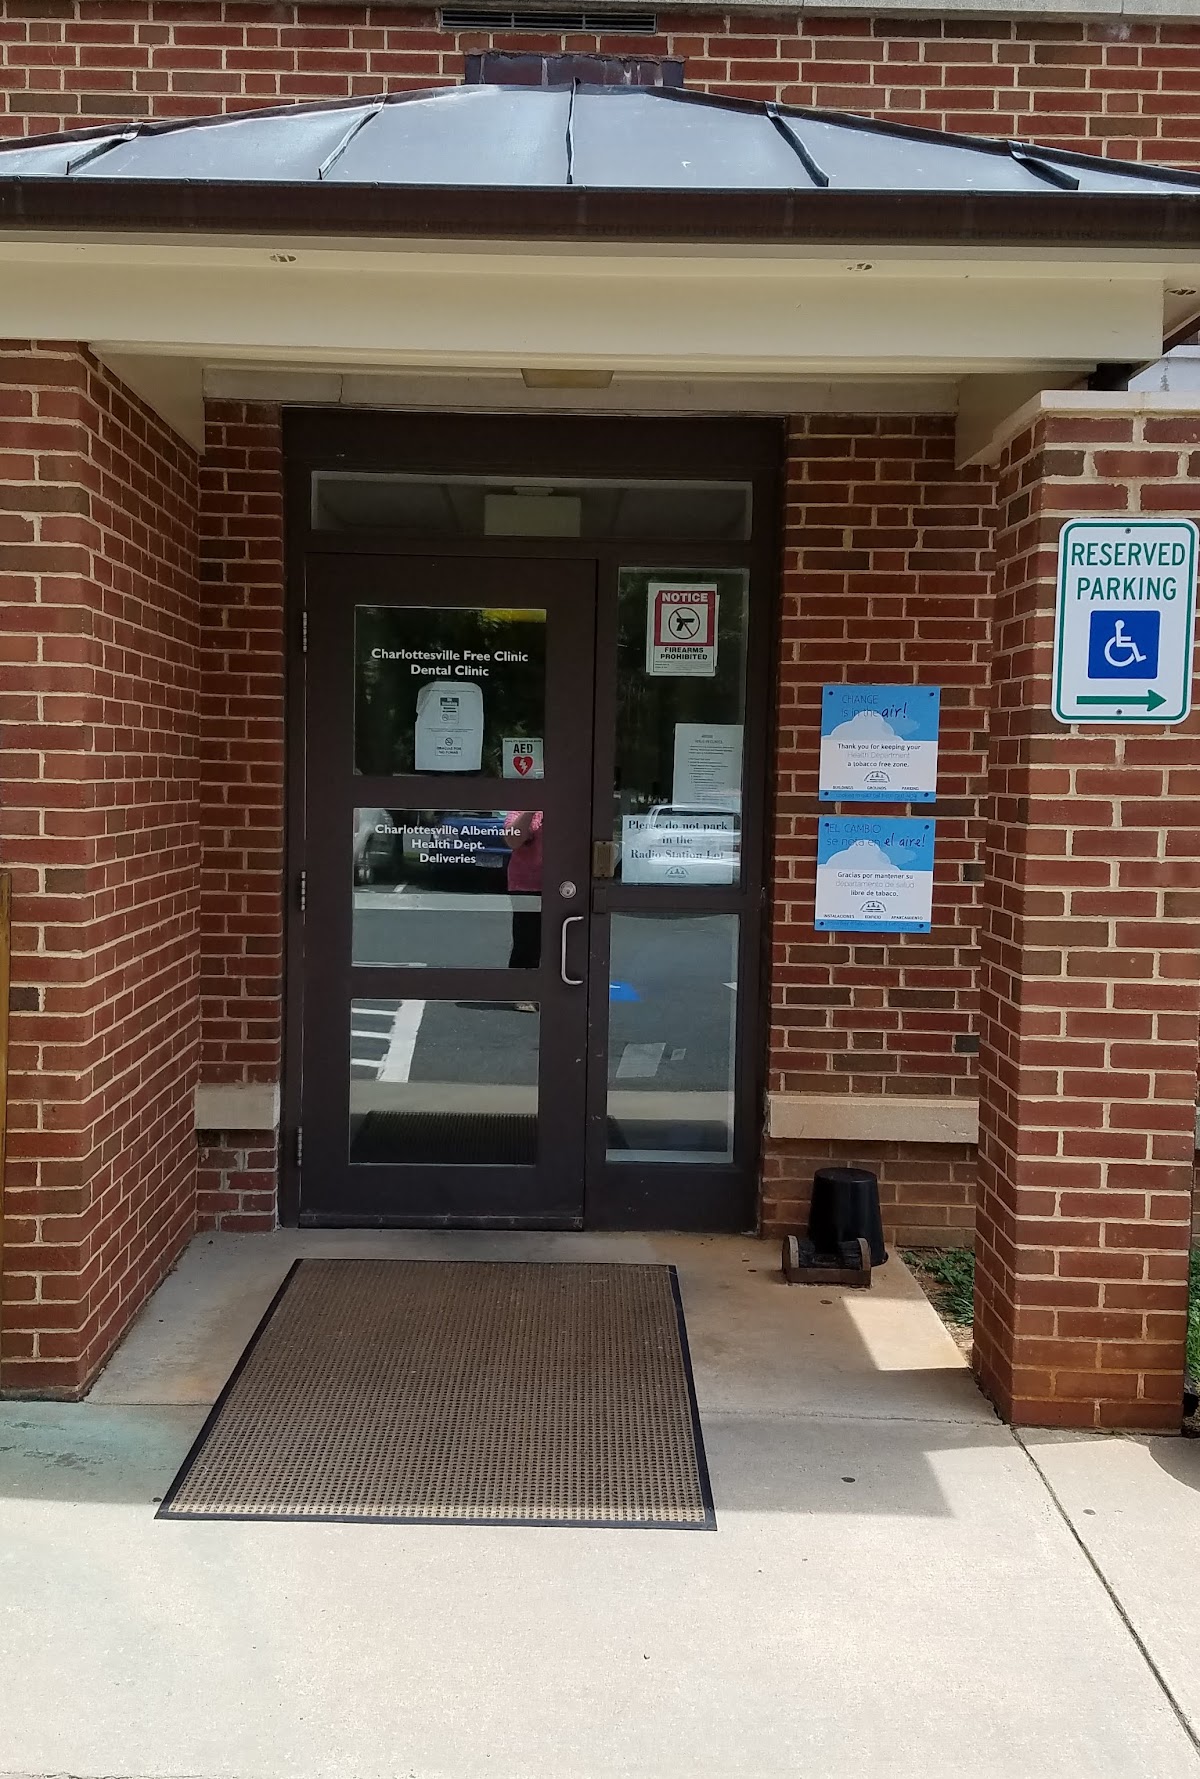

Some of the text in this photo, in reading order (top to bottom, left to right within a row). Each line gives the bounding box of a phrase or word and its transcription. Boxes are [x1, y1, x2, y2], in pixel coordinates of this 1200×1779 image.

[1071, 542, 1186, 566] RESERVED
[1077, 577, 1177, 600] PARKING
[662, 592, 708, 602] NOTICE
[372, 648, 528, 662] Charlottesville Free Clinic
[411, 664, 489, 676] Dental Clinic
[842, 694, 878, 704] CHANGE
[842, 708, 848, 717] is
[863, 709, 878, 717] the
[882, 703, 907, 718] air!
[513, 744, 533, 753] AED
[375, 824, 521, 836] Charlottesville Albemarle
[628, 820, 662, 830] Please
[666, 820, 678, 829] do
[704, 821, 728, 831] park
[845, 824, 881, 833] CAMBIO
[412, 839, 485, 852] Health Dept.
[662, 836, 693, 844] in the
[842, 838, 864, 846] nota
[884, 833, 894, 846] el
[899, 834, 925, 847] aire!
[420, 853, 476, 864] Deliveries
[631, 850, 724, 859] Radio Station Lot
